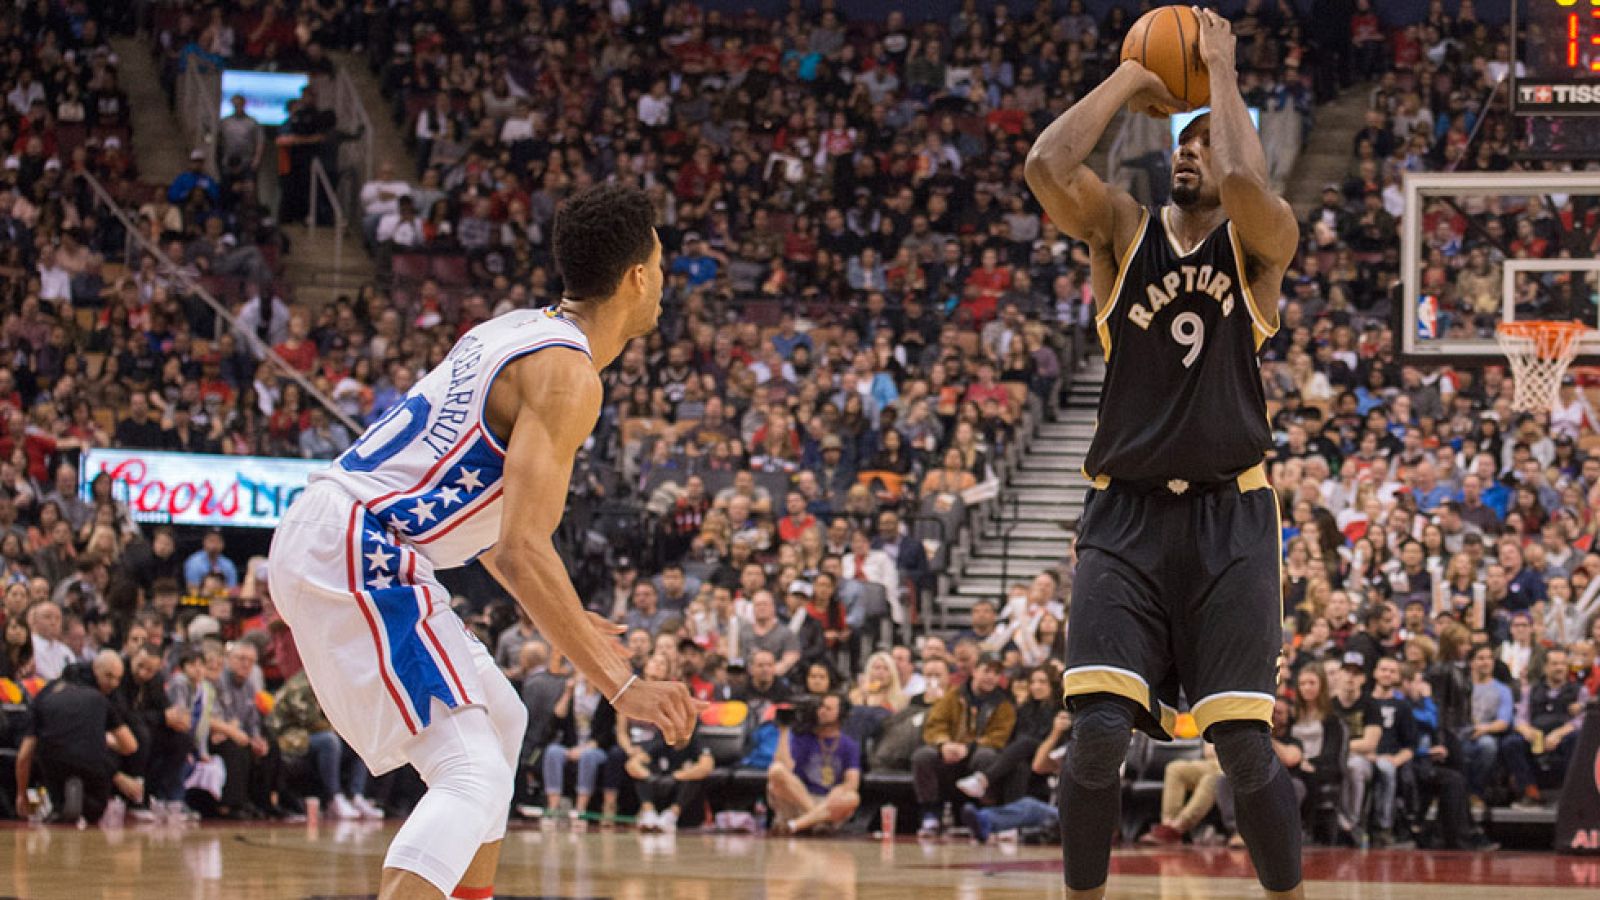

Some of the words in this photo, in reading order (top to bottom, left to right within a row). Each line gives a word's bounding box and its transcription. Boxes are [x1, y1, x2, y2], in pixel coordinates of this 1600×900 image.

[1567, 12, 1600, 71] 1
[1128, 265, 1235, 330] RAPTORS
[1171, 312, 1205, 368] 9
[340, 394, 431, 472] 0
[101, 459, 240, 517] Coors
